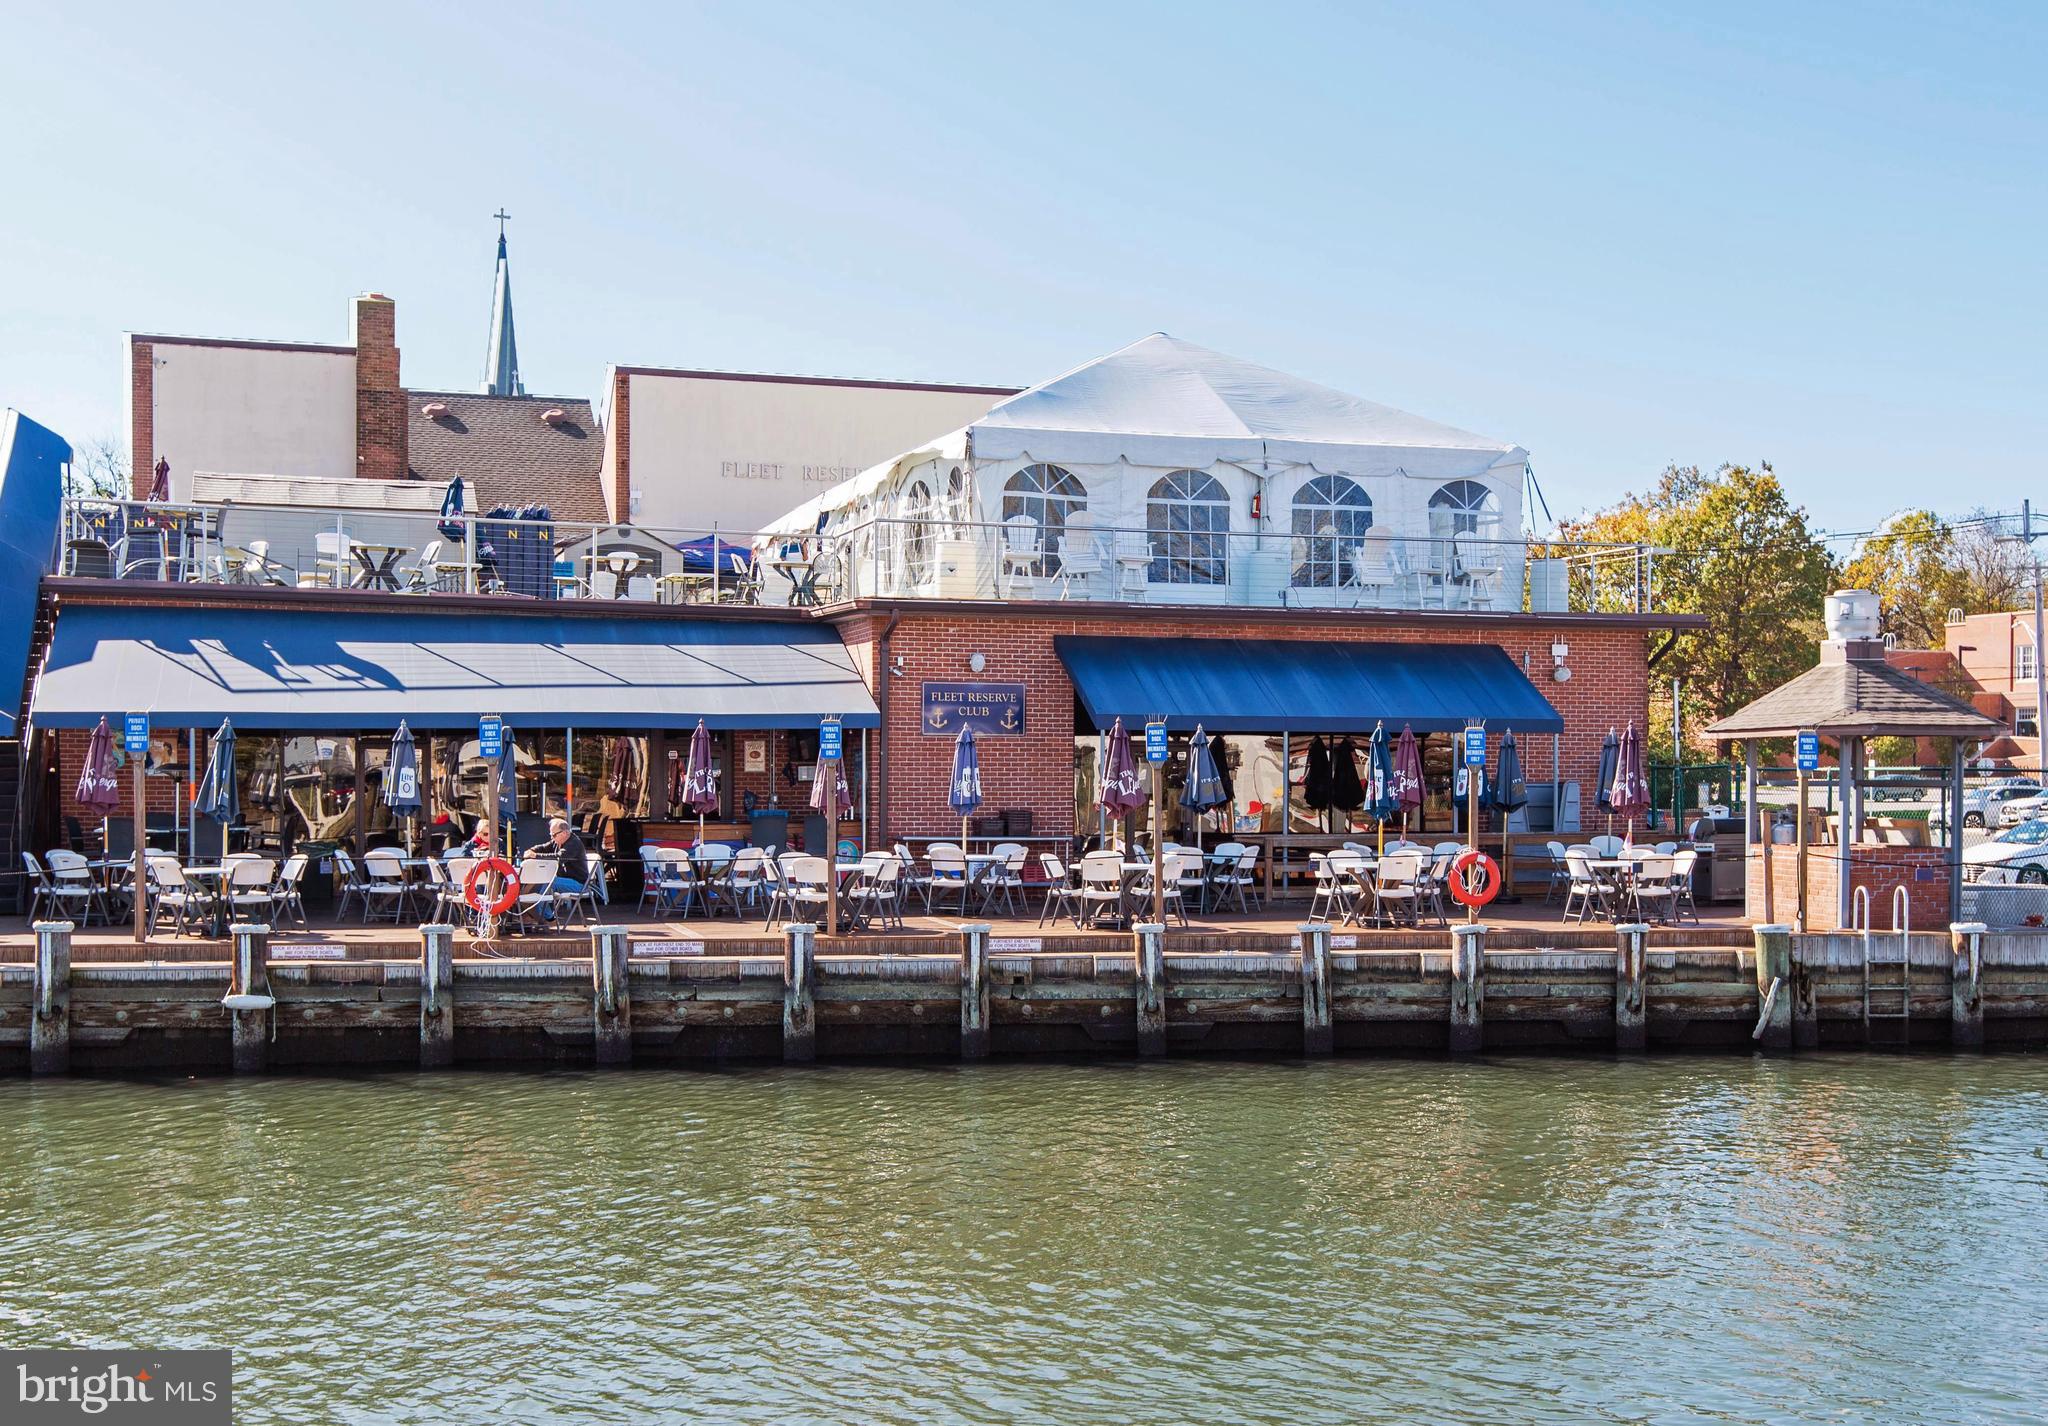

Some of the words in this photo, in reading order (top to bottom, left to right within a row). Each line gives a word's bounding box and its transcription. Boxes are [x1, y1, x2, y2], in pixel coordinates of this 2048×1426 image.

[721, 461, 784, 481] FLEET
[803, 464, 864, 482] RESE
[931, 692, 965, 702] FLEET
[968, 693, 1017, 703] RESERVE
[958, 706, 990, 716] CLUB
[401, 773, 413, 782] Lite
